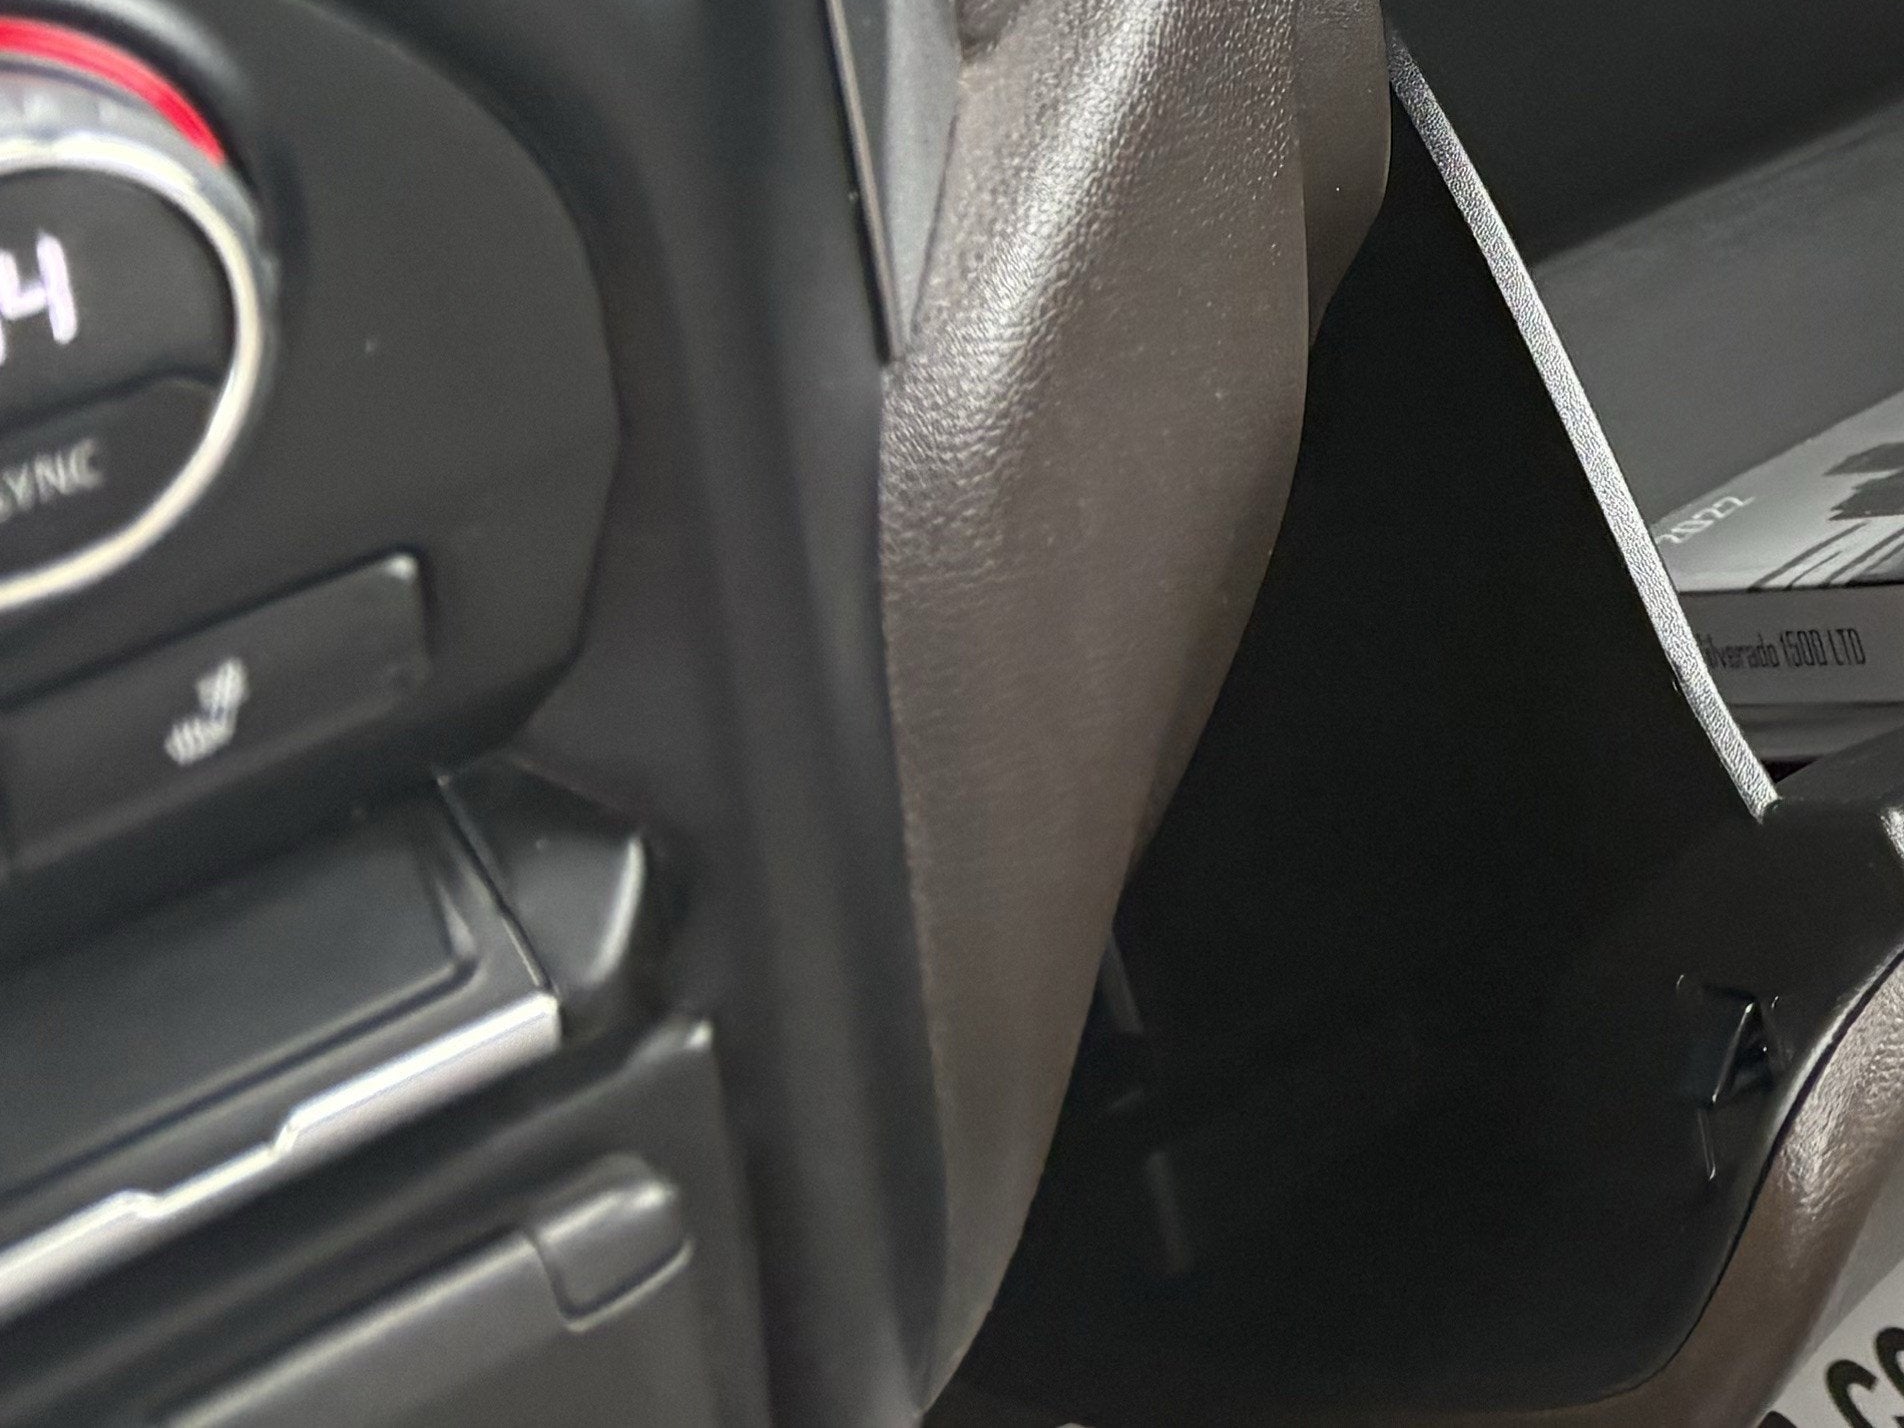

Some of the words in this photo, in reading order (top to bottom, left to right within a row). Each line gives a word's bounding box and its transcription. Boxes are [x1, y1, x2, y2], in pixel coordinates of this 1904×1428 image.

[0, 230, 79, 366] 4
[1654, 496, 1757, 545] 2022
[1697, 631, 1781, 671] ilverado
[1780, 629, 1829, 669] 1500
[1827, 627, 1867, 667] LTD
